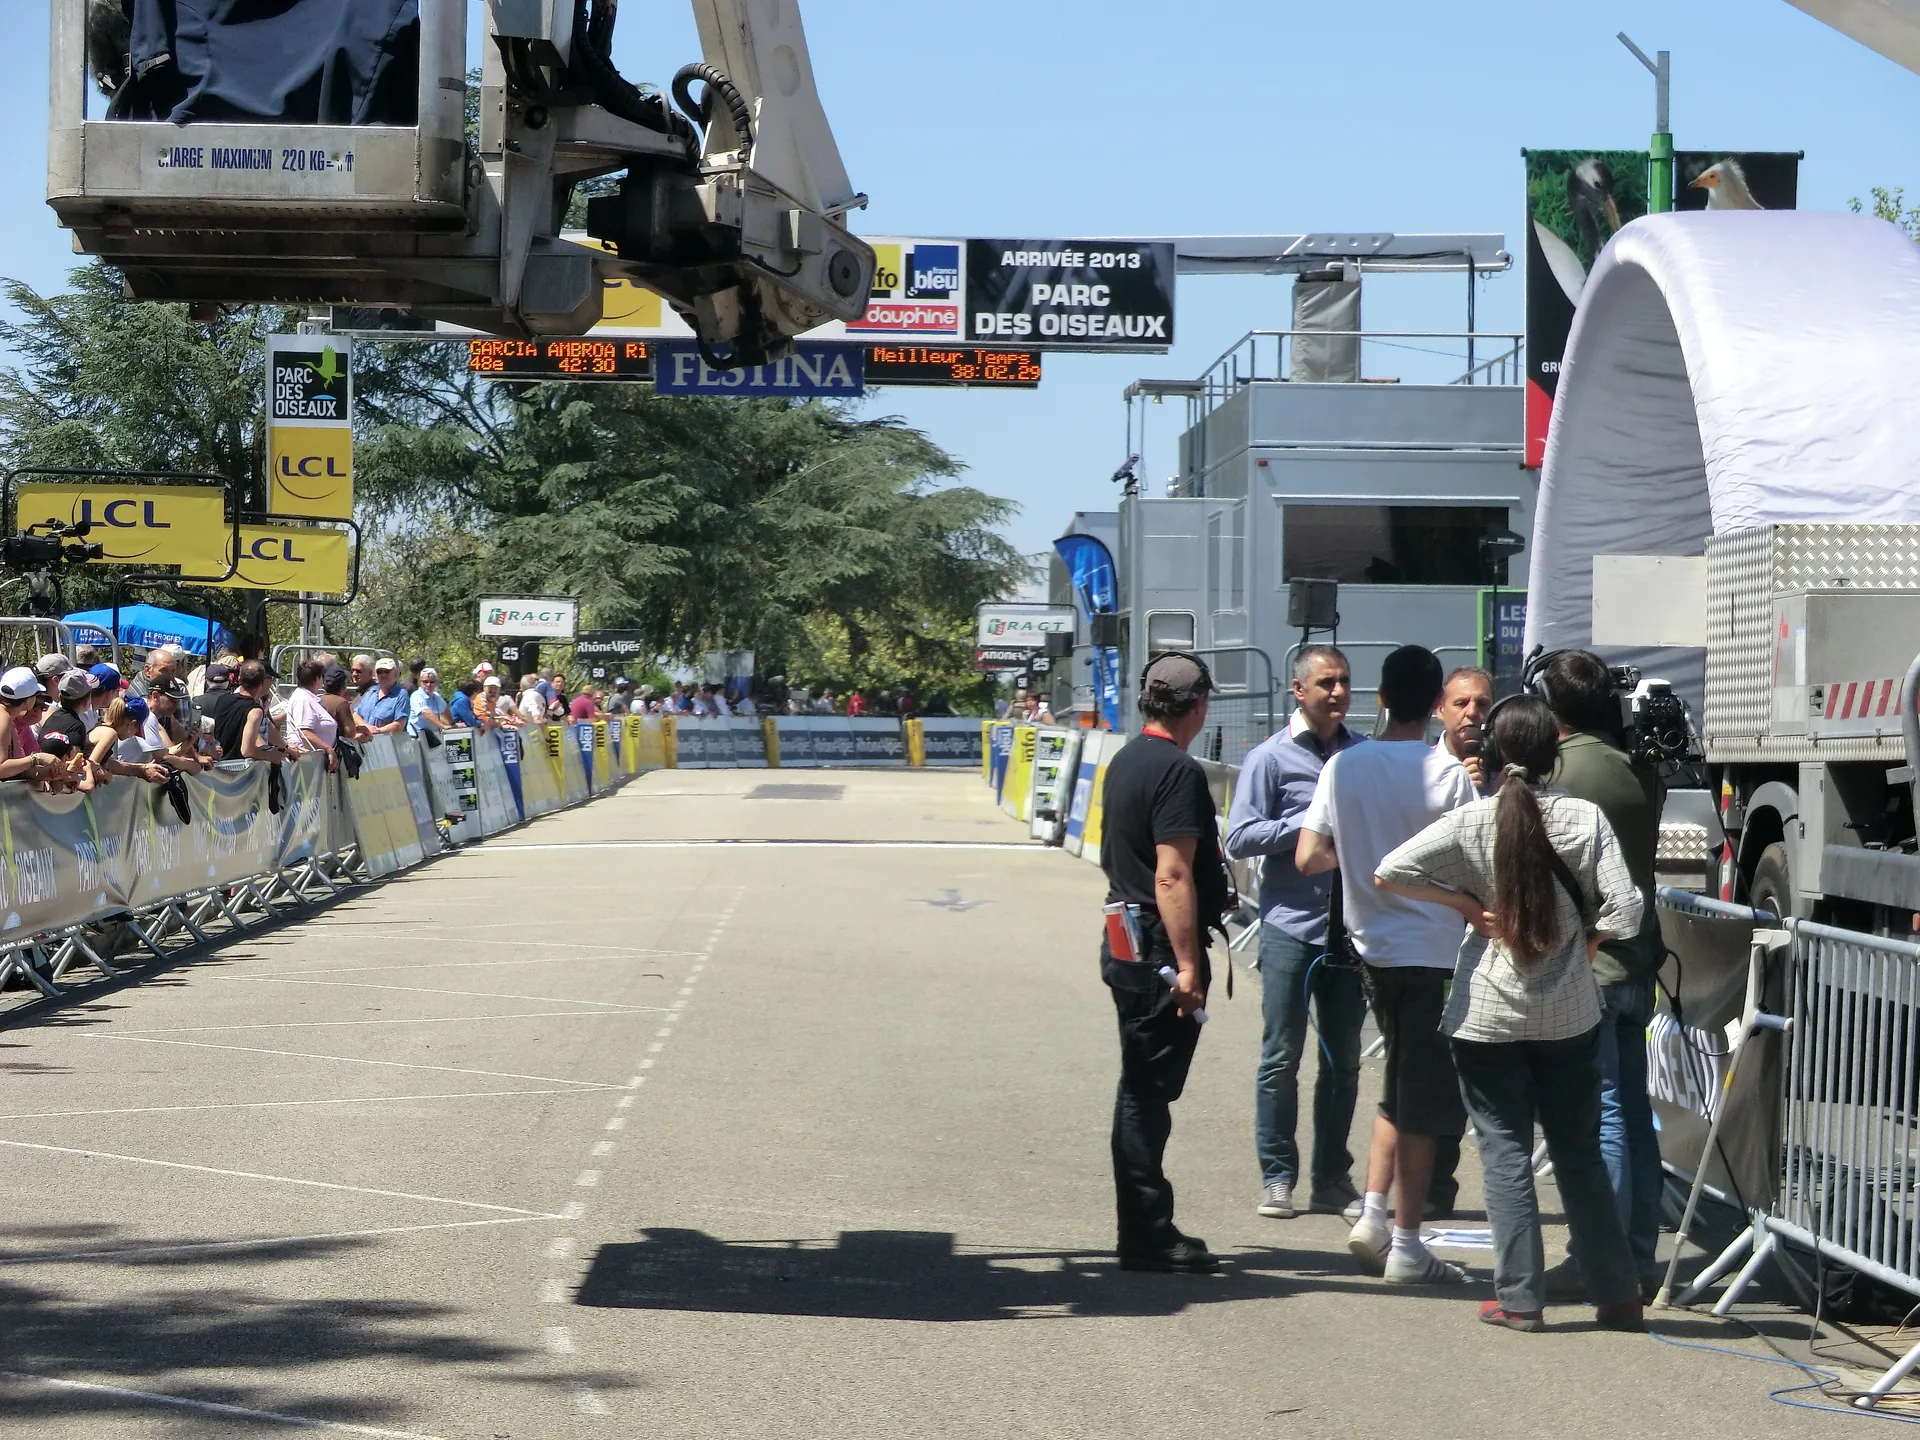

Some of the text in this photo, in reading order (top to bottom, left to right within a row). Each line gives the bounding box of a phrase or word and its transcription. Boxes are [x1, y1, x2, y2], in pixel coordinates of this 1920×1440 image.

[211, 147, 272, 170] MAXIMUM
[281, 149, 305, 171] 220
[1000, 249, 1141, 269] ARRIVÉE 2013
[873, 267, 898, 288] fo
[914, 270, 957, 289] bleu
[1032, 283, 1110, 307] PARC
[866, 306, 956, 328] dauphiné
[975, 313, 1166, 338] DES OISEAUX
[469, 340, 647, 358] GARCIA AMBROA Ri
[873, 347, 1031, 365] Meilleur Temps
[558, 357, 616, 373] 42:30
[951, 364, 1041, 380] 38:02.29
[276, 367, 313, 384] PARC
[276, 384, 304, 400] DES
[275, 400, 337, 417] OISEAUX
[282, 456, 346, 477] LCL
[81, 499, 171, 529] LCL
[239, 536, 305, 563] LCL
[508, 610, 566, 622] RAGT
[1006, 621, 1066, 632] RAGT
[1501, 626, 1518, 638] DU
[502, 647, 519, 661] 25
[1032, 657, 1050, 671] 25
[592, 667, 605, 678] 50
[503, 730, 519, 765] bleu
[545, 729, 560, 757] info
[580, 725, 593, 752] bleu
[999, 727, 1012, 757] bleu
[1021, 731, 1036, 763] info
[15, 847, 57, 905] OISEAUX
